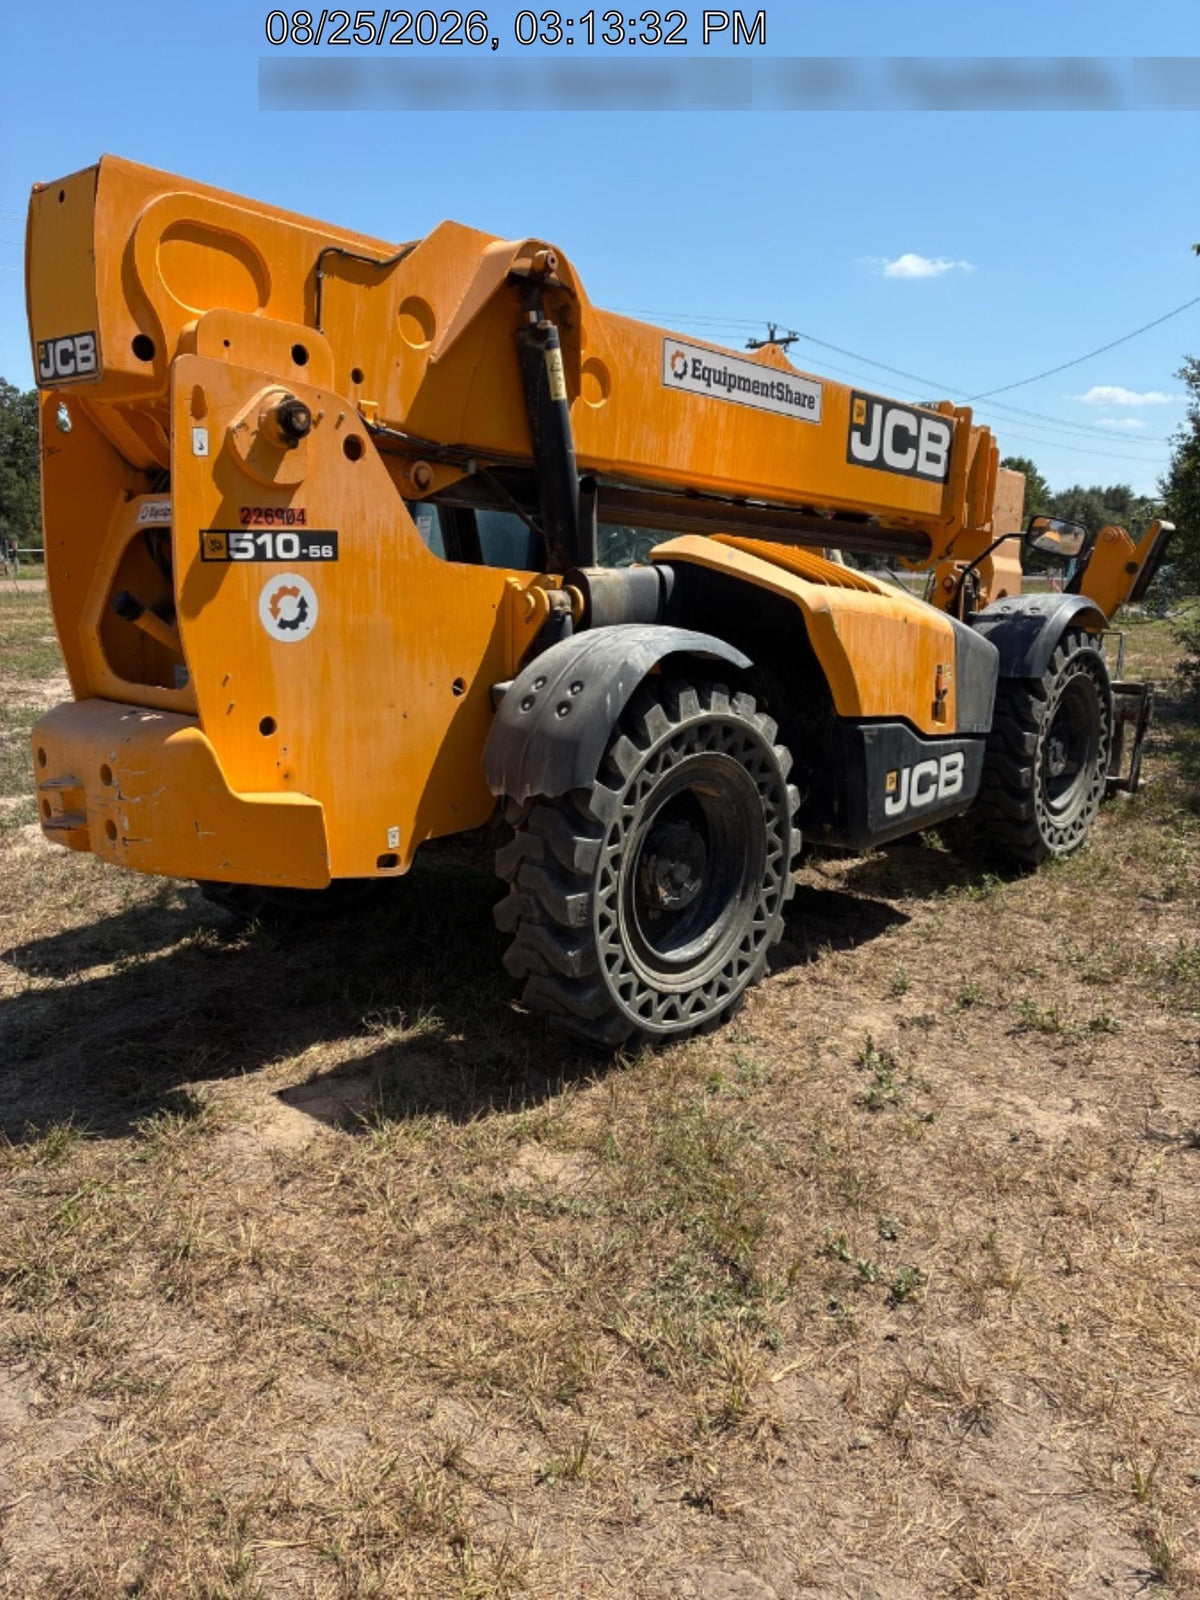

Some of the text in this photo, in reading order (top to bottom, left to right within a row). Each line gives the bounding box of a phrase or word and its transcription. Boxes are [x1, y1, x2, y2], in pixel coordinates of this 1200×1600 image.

[40, 334, 97, 377] JCB
[691, 358, 815, 409] EquipmentShare
[851, 403, 950, 477] JCB
[240, 507, 306, 525] 226904
[228, 532, 333, 559] 510-56
[884, 751, 964, 815] JCB
